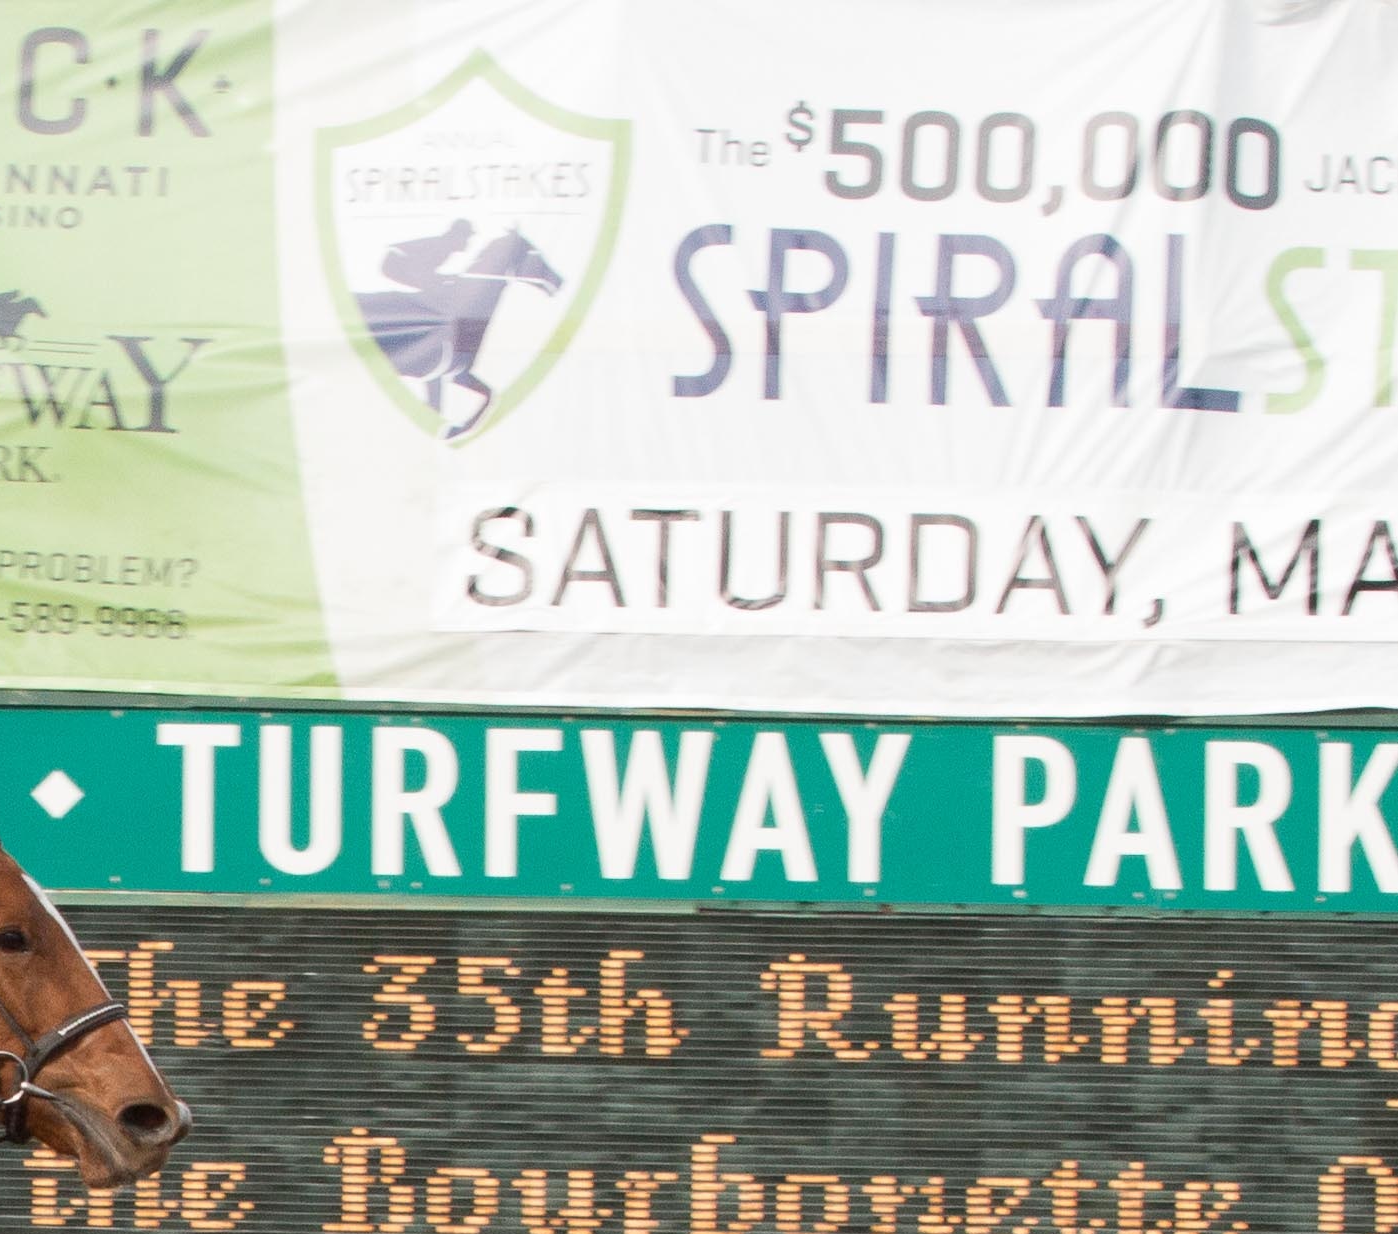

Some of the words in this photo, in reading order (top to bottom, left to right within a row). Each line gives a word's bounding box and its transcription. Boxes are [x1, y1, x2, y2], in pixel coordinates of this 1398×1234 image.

[695, 128, 773, 168] The
[784, 100, 1281, 217] $500,000
[465, 506, 1166, 631] SATURDAY,
[156, 722, 914, 886] TURFWAY
[991, 735, 1398, 894] PARK
[83, 940, 296, 1047] he
[361, 950, 691, 1057] 35th
